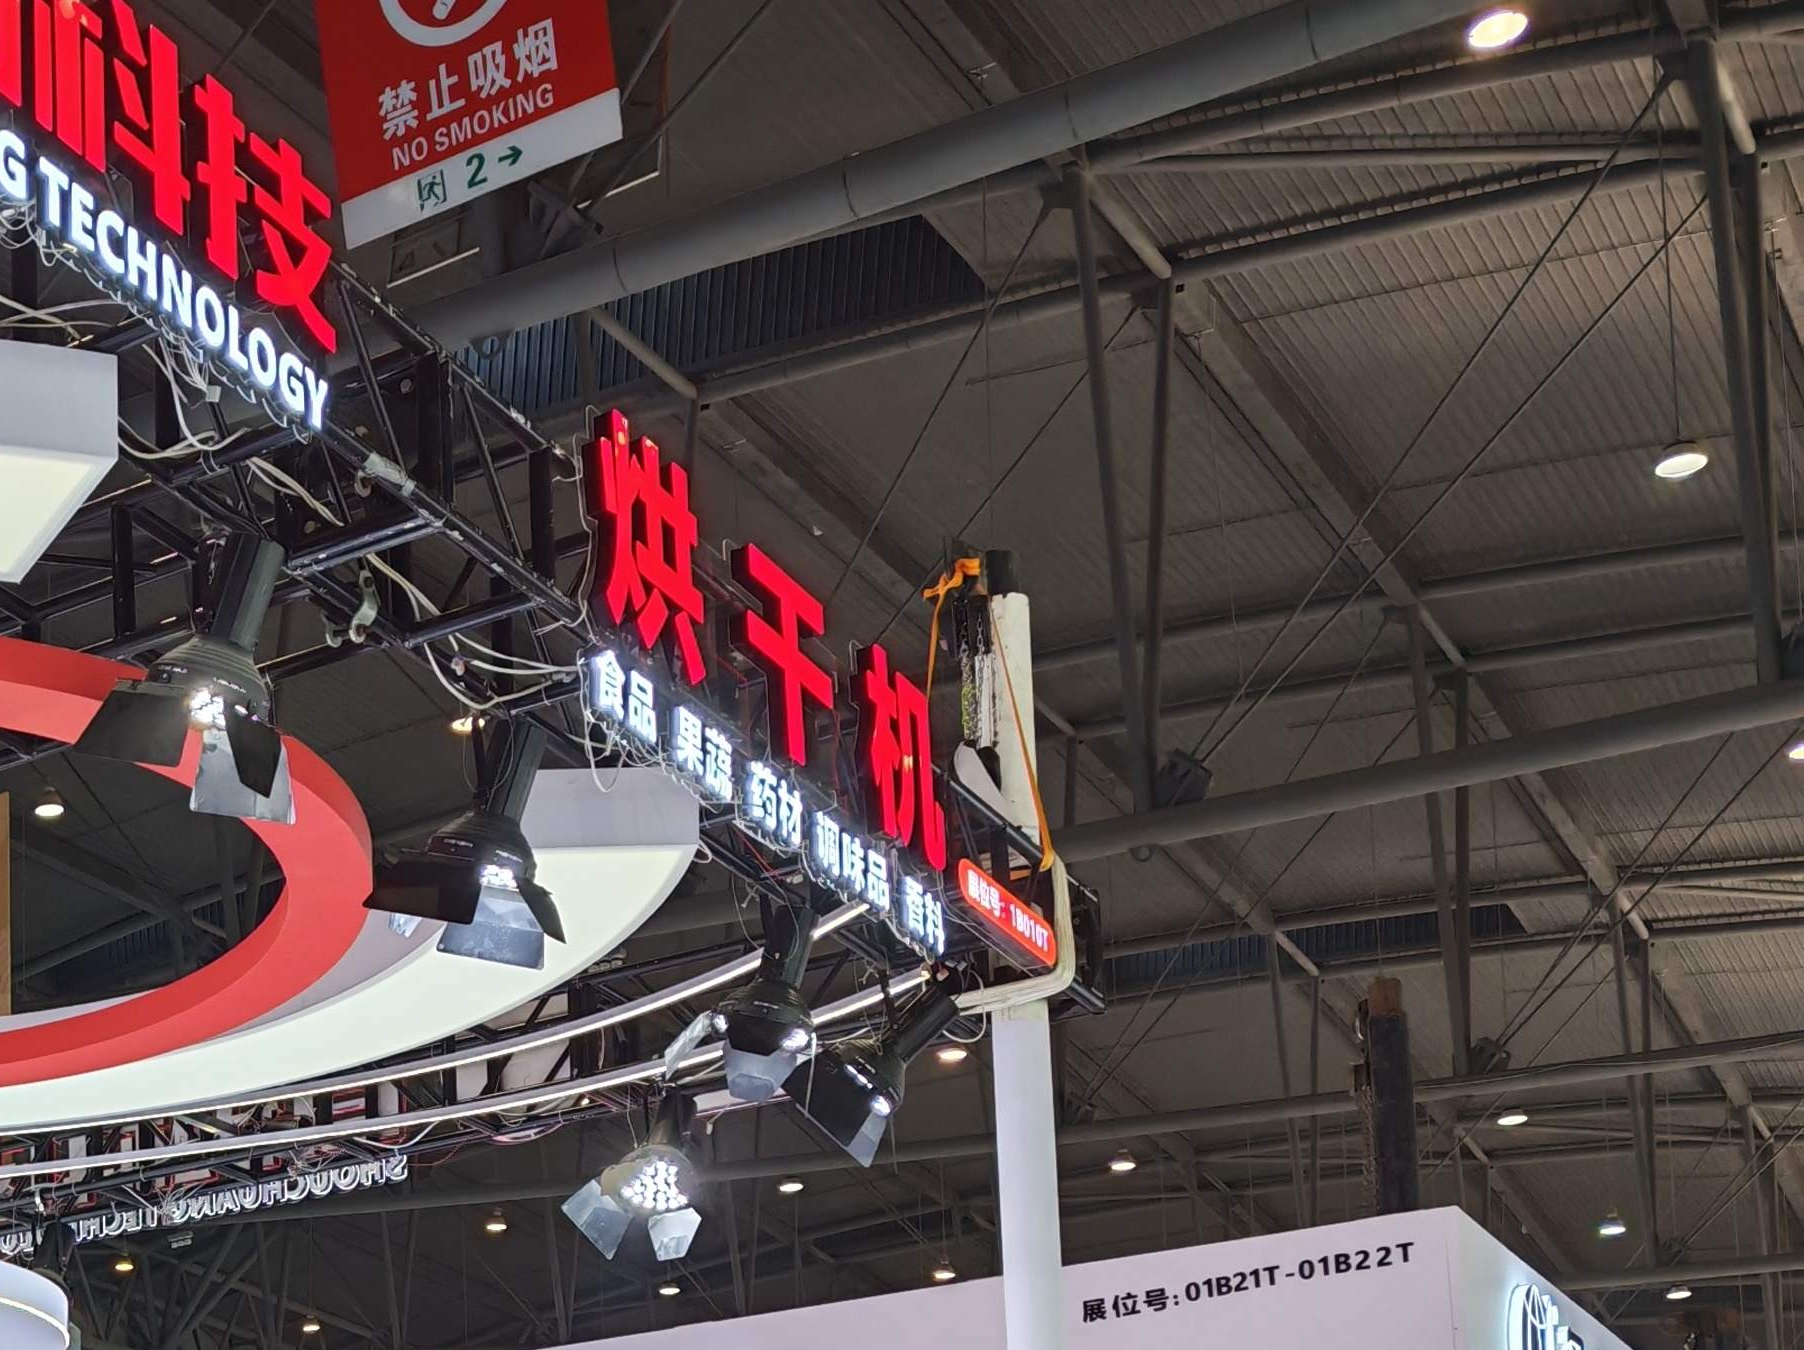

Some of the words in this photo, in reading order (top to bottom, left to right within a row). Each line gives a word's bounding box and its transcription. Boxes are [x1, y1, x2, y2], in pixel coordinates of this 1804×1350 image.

[378, 18, 559, 140] 禁止吸烟
[392, 137, 428, 170] NO
[434, 83, 555, 151] SMOKING
[466, 153, 488, 189] 2
[38, 155, 329, 429] TECHNOLOGY
[598, 409, 946, 871] 烘干机
[593, 650, 657, 745] 食品
[673, 705, 733, 801] 果蔬
[747, 761, 803, 849] 药材
[813, 809, 891, 911] 调味品
[903, 876, 947, 957] 香料
